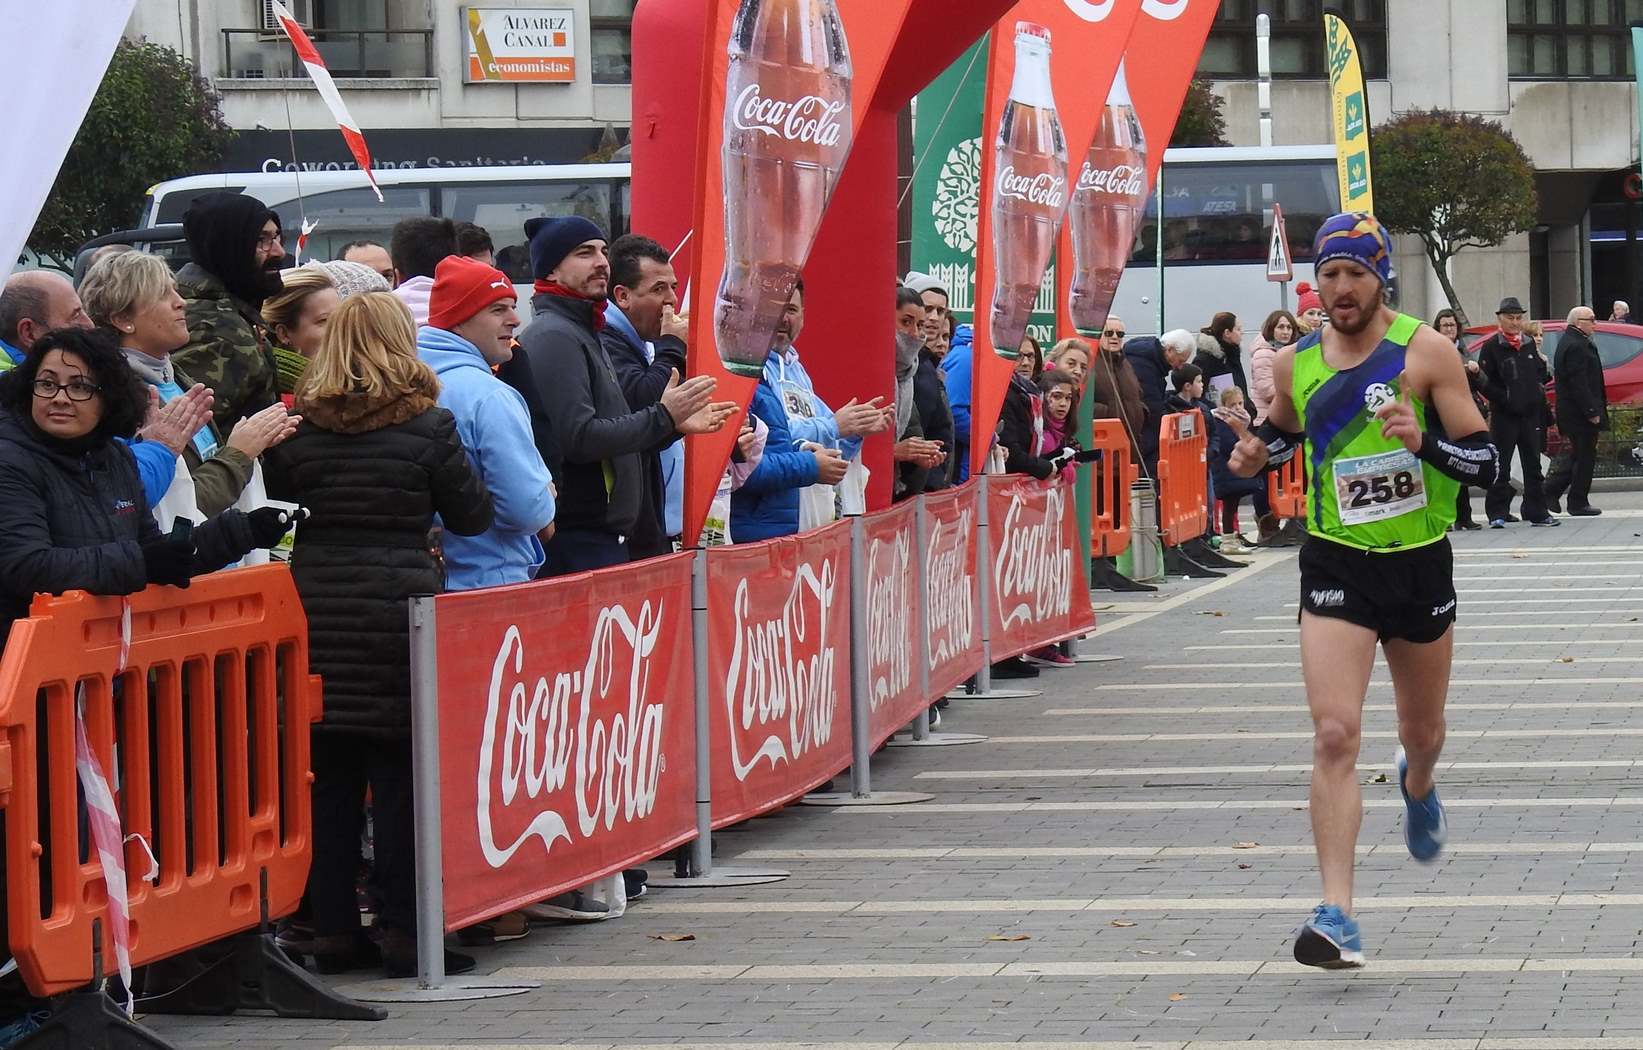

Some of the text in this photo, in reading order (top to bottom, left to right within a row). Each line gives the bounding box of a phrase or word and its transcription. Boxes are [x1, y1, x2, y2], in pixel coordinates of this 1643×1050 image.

[504, 33, 552, 47] CANAL
[489, 60, 570, 73] economistas
[733, 84, 845, 146] Coca-Cola
[262, 158, 417, 172] Coworing
[1076, 161, 1143, 195] Coca-Cola
[999, 165, 1064, 207] Coca-Cola
[1348, 471, 1414, 507] 258
[996, 487, 1071, 631] Coca-Cola
[727, 552, 838, 782] Coca-Cola
[477, 596, 664, 868] Coca-Cola
